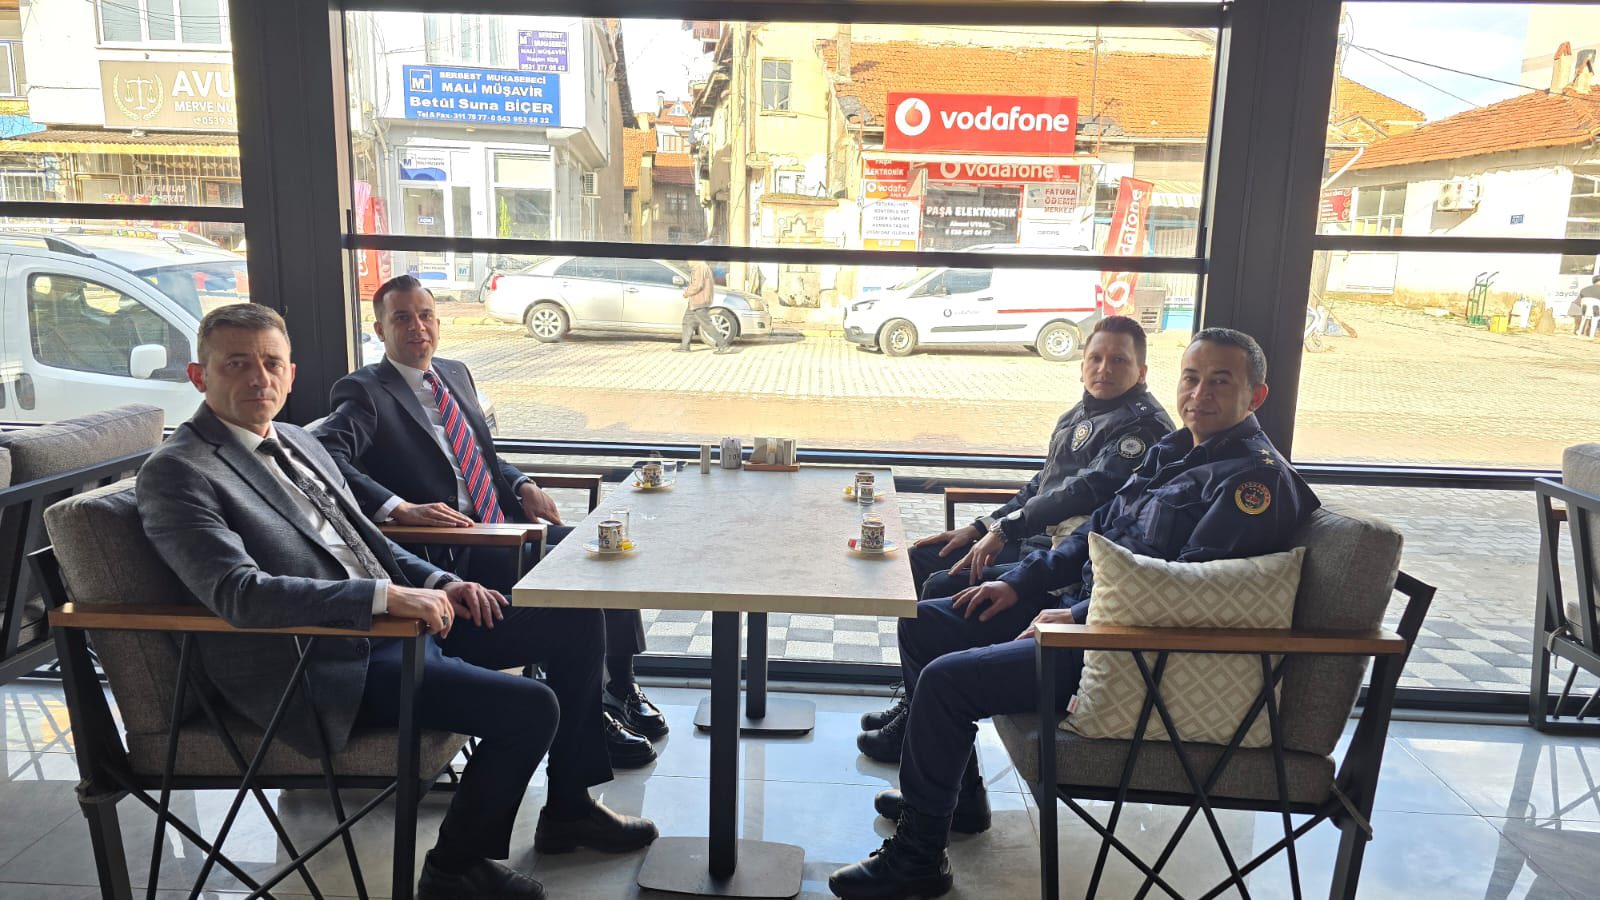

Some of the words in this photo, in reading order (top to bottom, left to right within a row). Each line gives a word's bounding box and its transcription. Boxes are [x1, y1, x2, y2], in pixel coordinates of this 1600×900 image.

[439, 71, 482, 81] SERBEST
[441, 82, 477, 94] MALİ
[481, 83, 543, 98] MÜŞAVİR
[175, 101, 214, 113] MERVE
[458, 98, 499, 111] Suna
[505, 100, 553, 114] BİÇER
[940, 105, 1070, 132] vodafone
[965, 163, 1055, 179] vodafone
[1044, 188, 1076, 196] FATURA
[1044, 196, 1076, 205] ÖDEME
[926, 206, 952, 218] PAŞA
[1120, 189, 1143, 257] dafone
